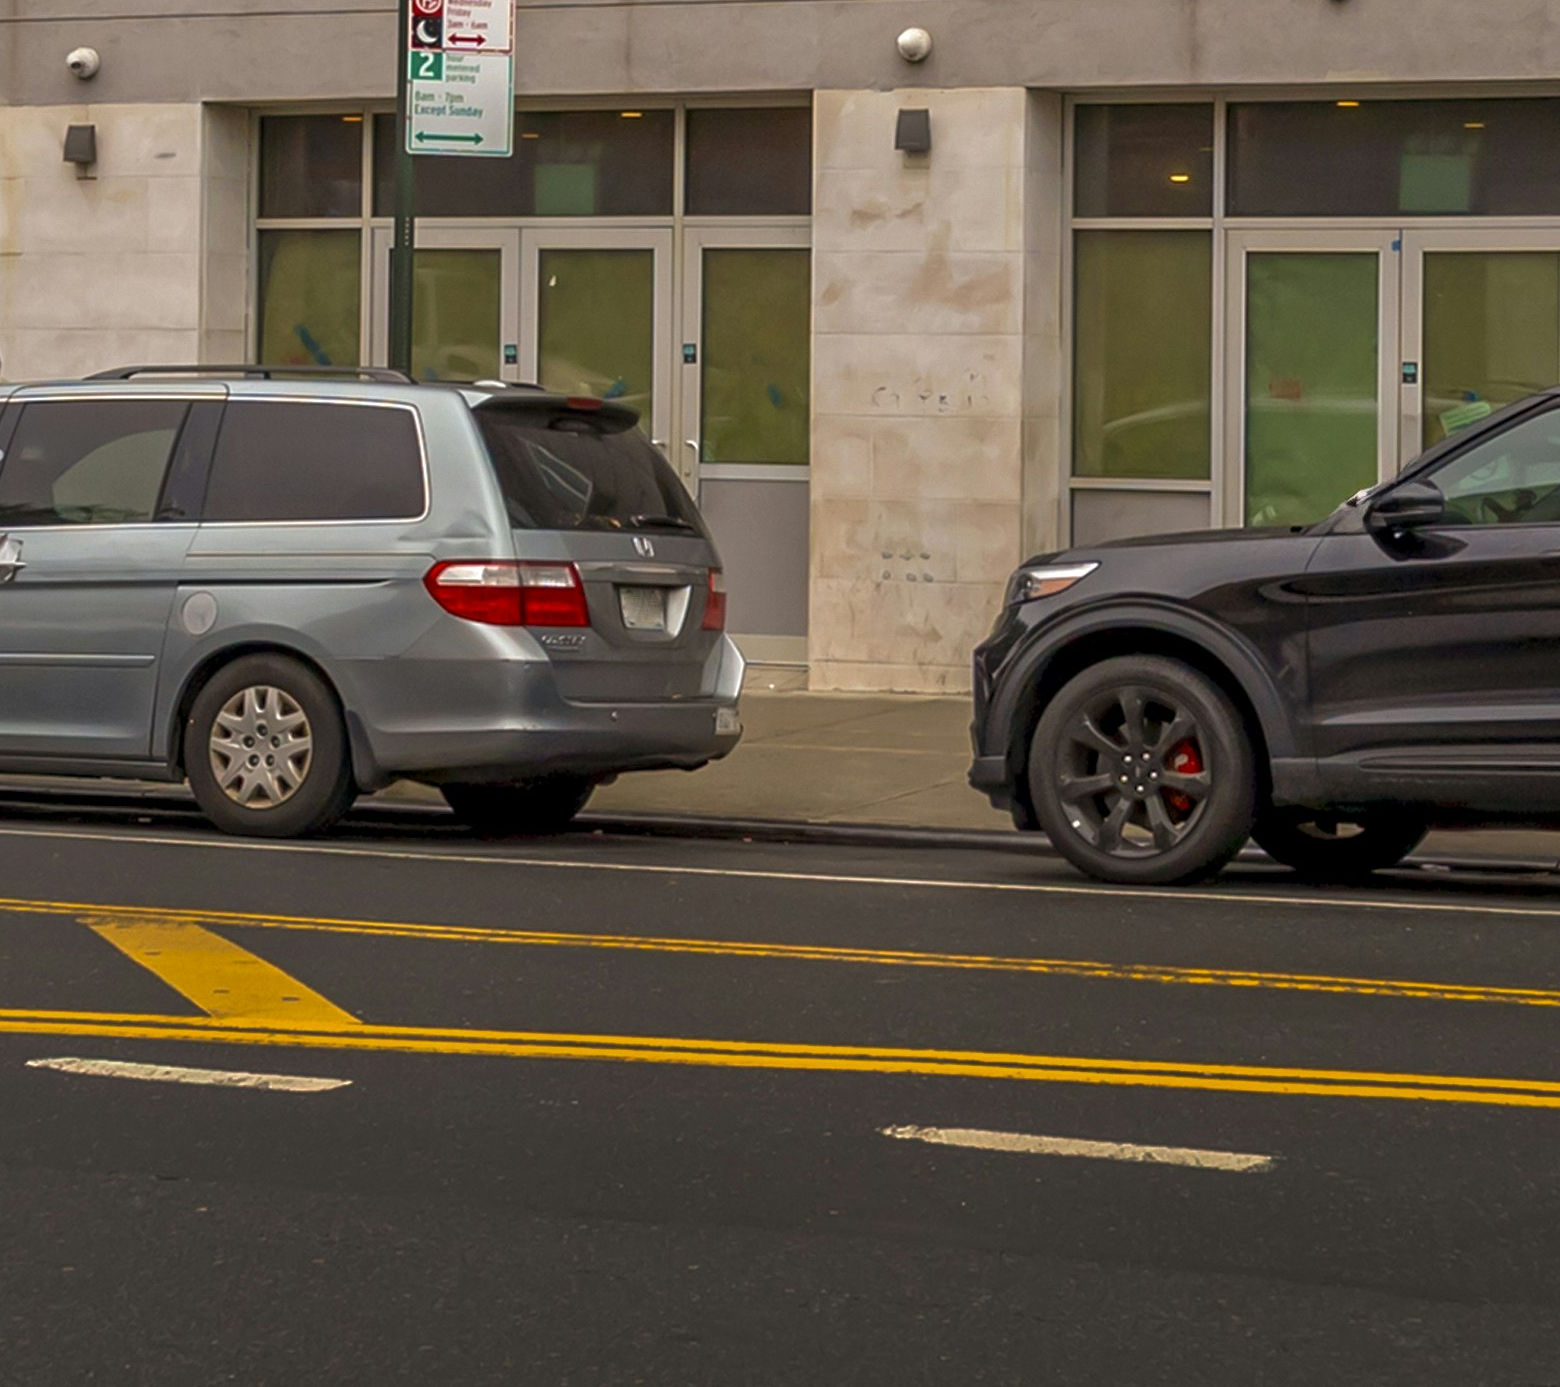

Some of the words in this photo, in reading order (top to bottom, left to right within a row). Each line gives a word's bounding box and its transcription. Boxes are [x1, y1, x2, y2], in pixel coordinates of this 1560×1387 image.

[448, 7, 471, 18] Friday
[419, 53, 434, 77] 2
[414, 104, 446, 116] Except
[449, 105, 483, 118] Sunday
